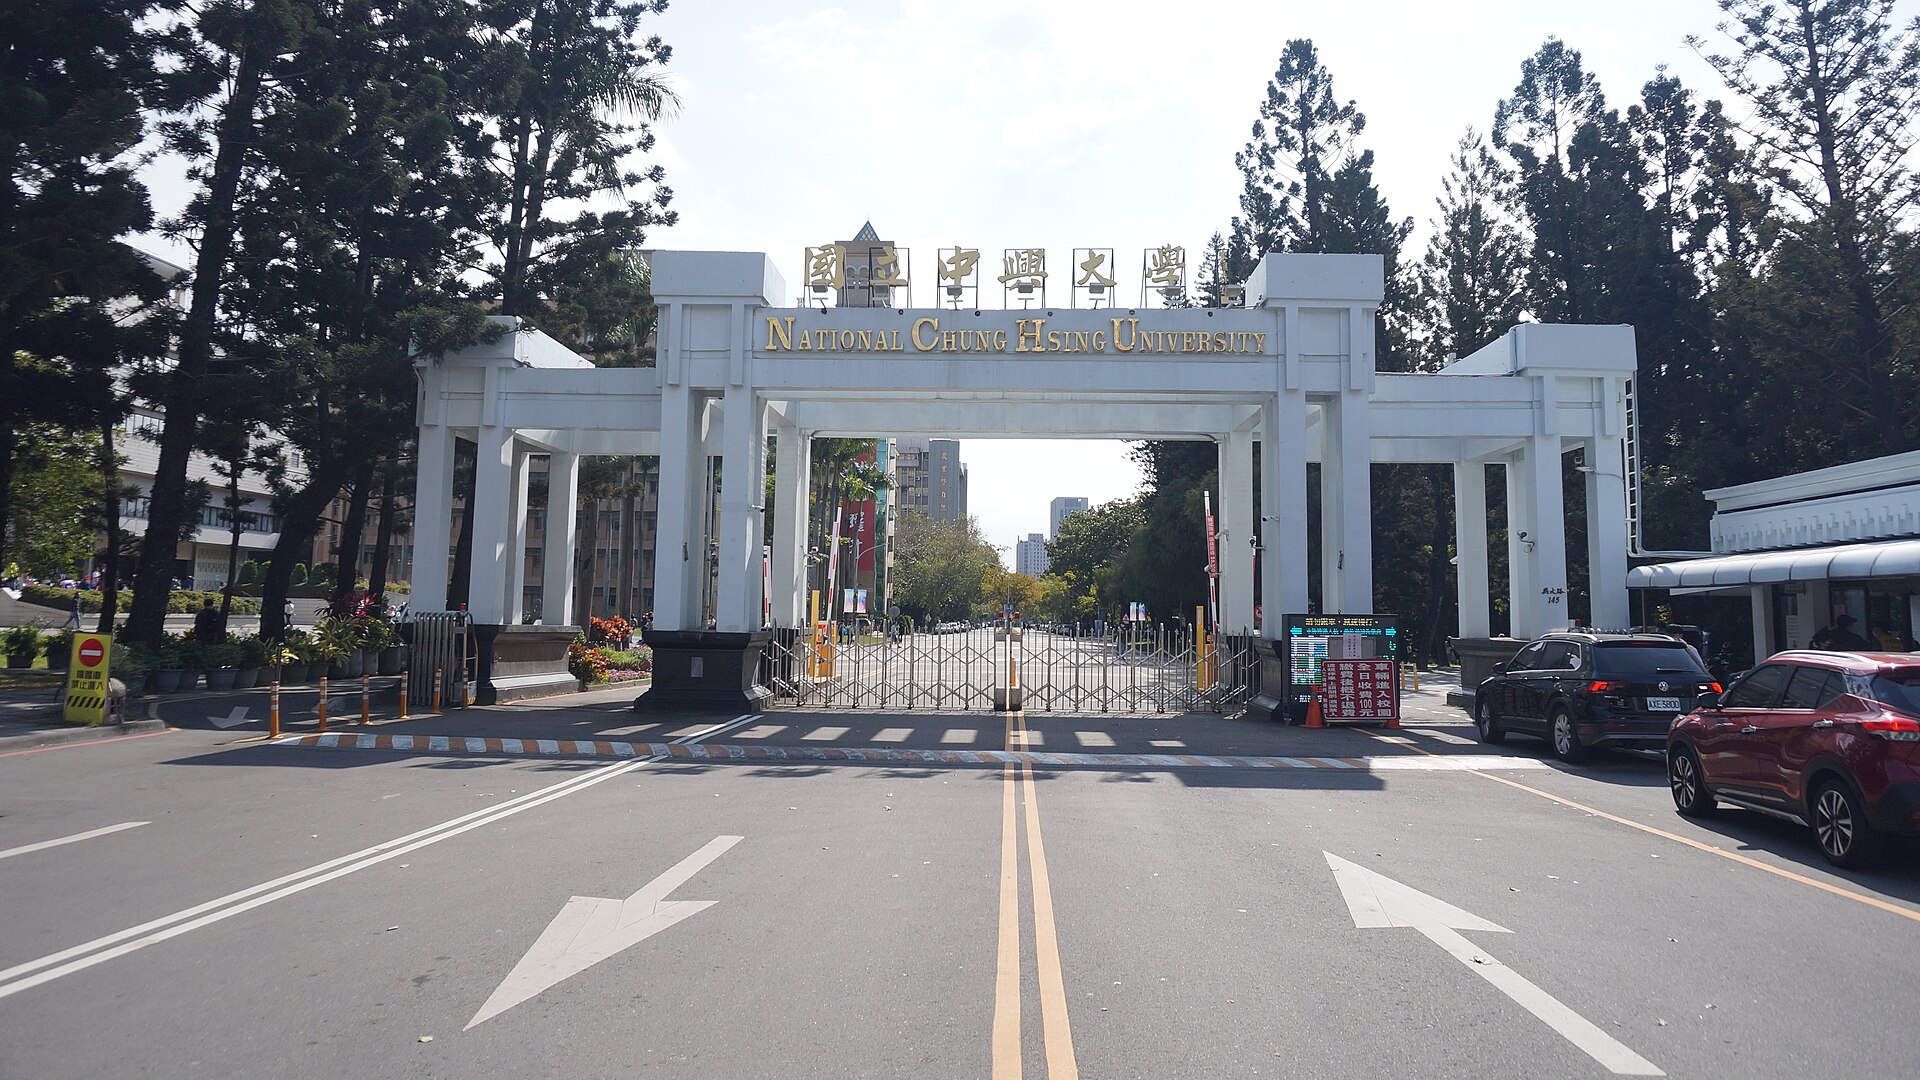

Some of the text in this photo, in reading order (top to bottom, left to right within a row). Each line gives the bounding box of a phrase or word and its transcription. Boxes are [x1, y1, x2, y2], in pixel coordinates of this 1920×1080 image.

[804, 243, 1186, 299] 國立中興大學
[765, 316, 1267, 353] NATIONAL CHUNG HSING UNIVERSITY
[1547, 596, 1560, 604] 145
[1374, 663, 1392, 717] 車輛進入校園
